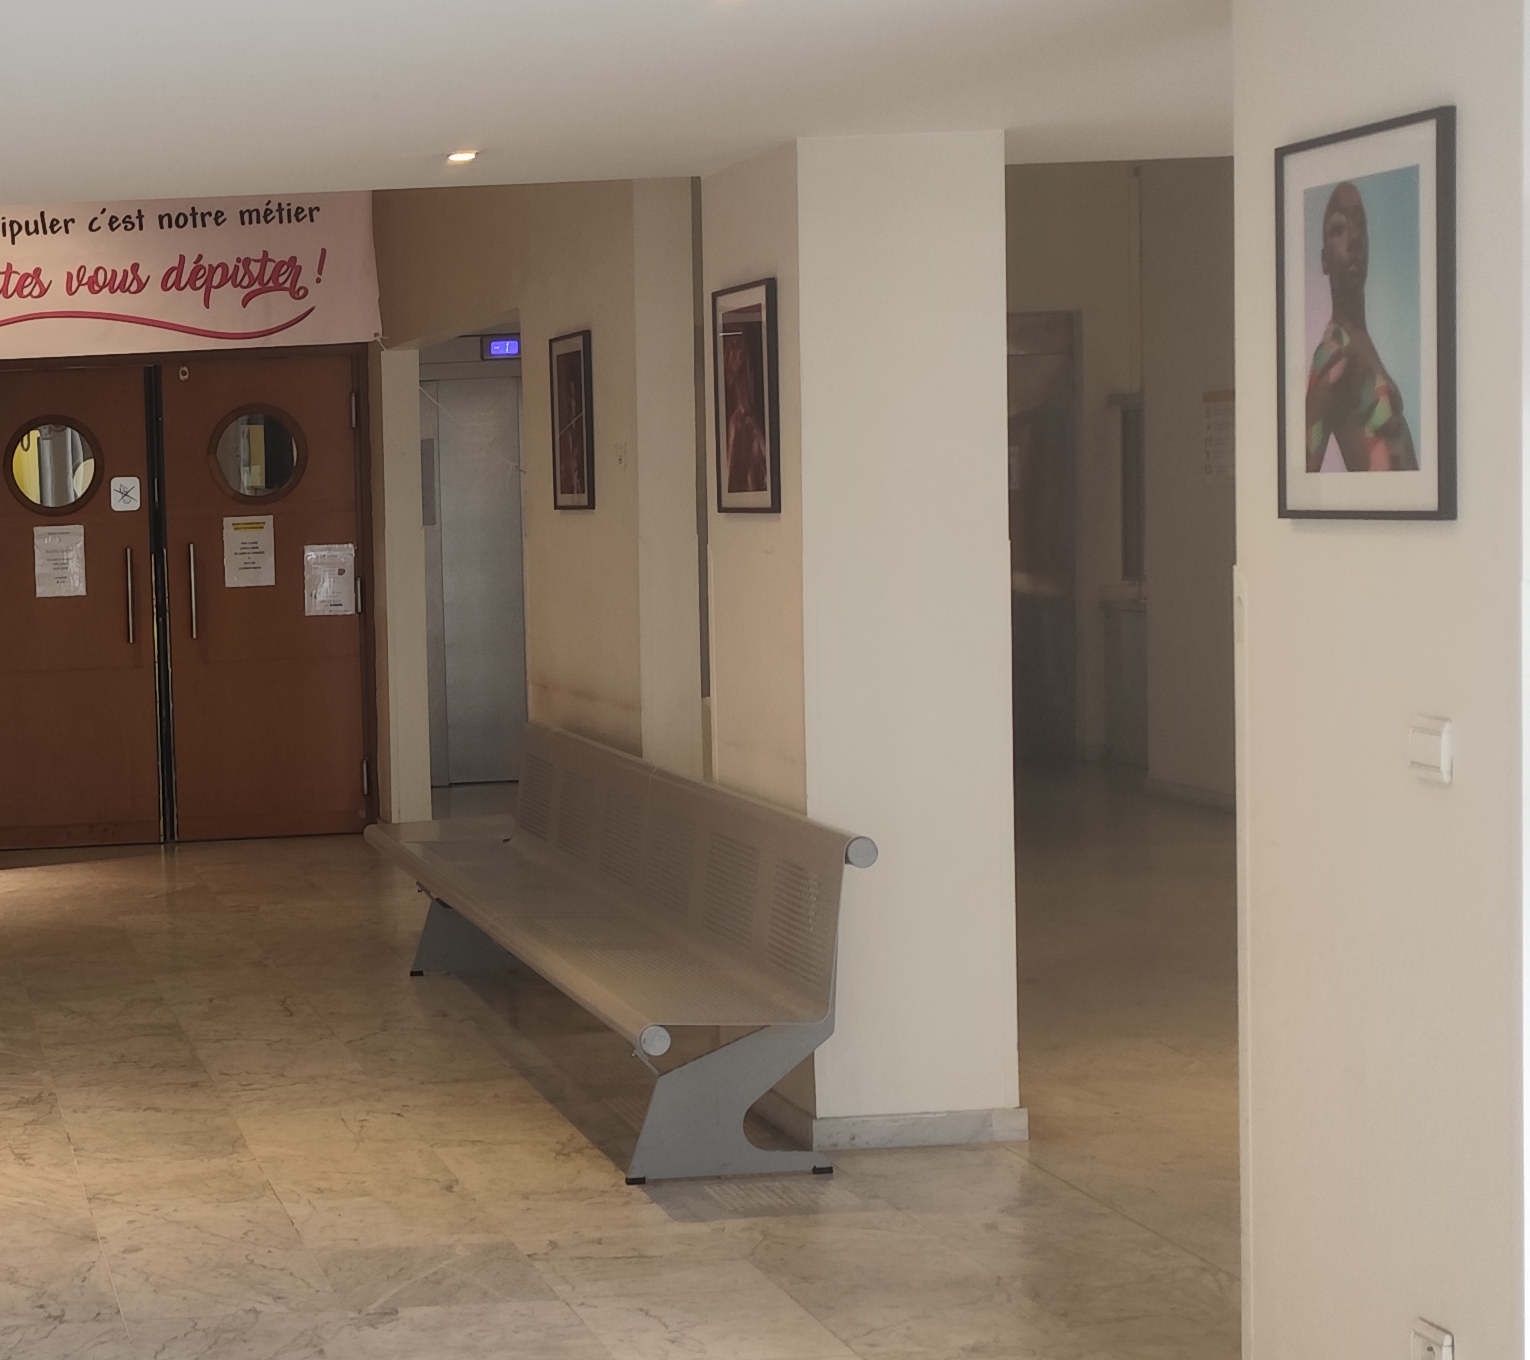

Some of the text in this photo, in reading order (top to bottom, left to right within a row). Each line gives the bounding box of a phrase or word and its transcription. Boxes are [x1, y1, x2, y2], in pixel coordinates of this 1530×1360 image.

[88, 207, 145, 233] c'est
[158, 206, 227, 230] notre
[239, 200, 321, 226] métier
[65, 261, 151, 297] vous
[160, 249, 309, 309] dépister
